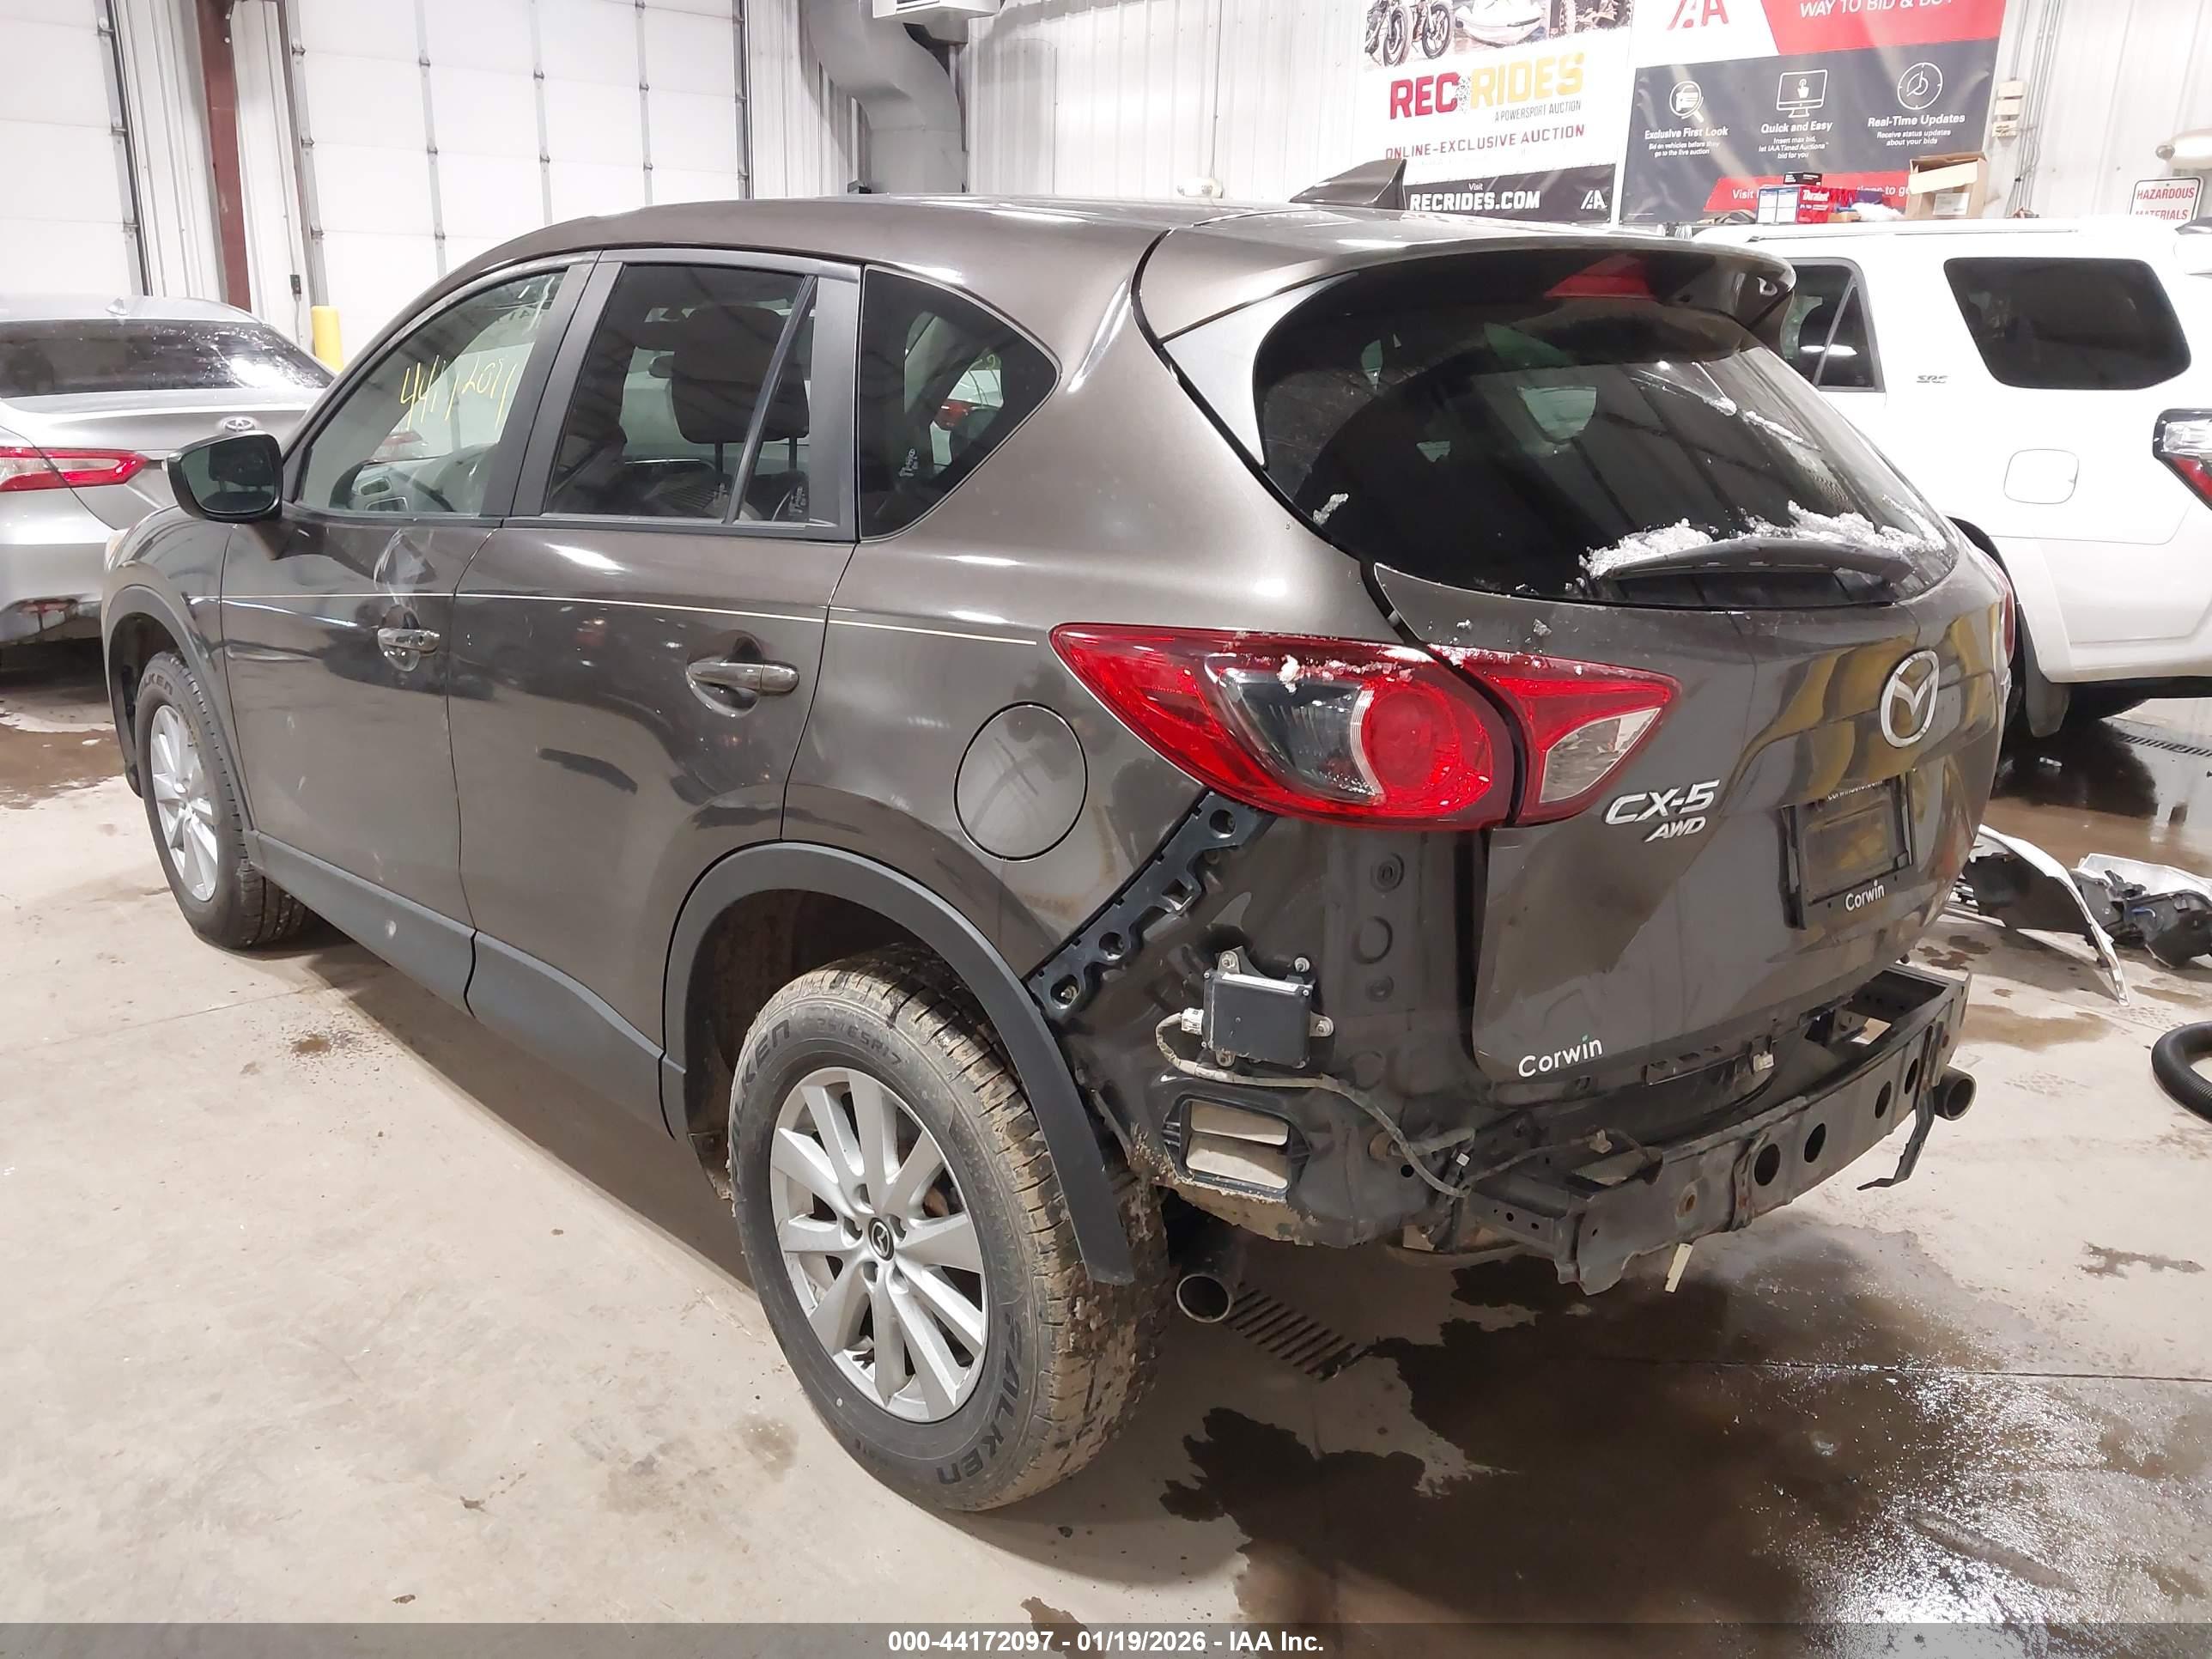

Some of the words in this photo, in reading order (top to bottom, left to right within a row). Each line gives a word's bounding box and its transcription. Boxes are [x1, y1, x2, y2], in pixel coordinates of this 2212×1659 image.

[1800, 0, 1835, 18] WAY
[1390, 71, 1461, 119] REC
[1470, 53, 1585, 109] RIDES
[1500, 104, 1547, 122] POWERSPORT
[1549, 100, 1582, 114] AUCTION
[1760, 123, 1789, 133] Quick
[1790, 122, 1808, 132] and
[1810, 120, 1833, 132] Easy
[1868, 115, 1918, 127] Real-Time
[1920, 113, 1966, 126] Updates
[1644, 129, 1682, 140] Exclusive
[1683, 127, 1703, 137] First
[1705, 126, 1729, 137] Look
[1923, 129, 1951, 137] updates
[1385, 133, 1516, 160] ONLINE-EXCLUSIVE
[1520, 124, 1585, 144] AUCTION
[1906, 137, 1923, 146] your
[1468, 182, 1484, 191] Visit
[1732, 188, 1753, 199] Visit
[1884, 185, 1896, 195] to
[2136, 187, 2195, 200] HAZARDOUS
[1410, 190, 1540, 211] RECRIDES.COM
[1605, 779, 1720, 824] CX-5
[1644, 816, 1706, 842] AWD
[1845, 878, 1885, 911] Corwin
[1517, 1034, 1603, 1078] Corwin
